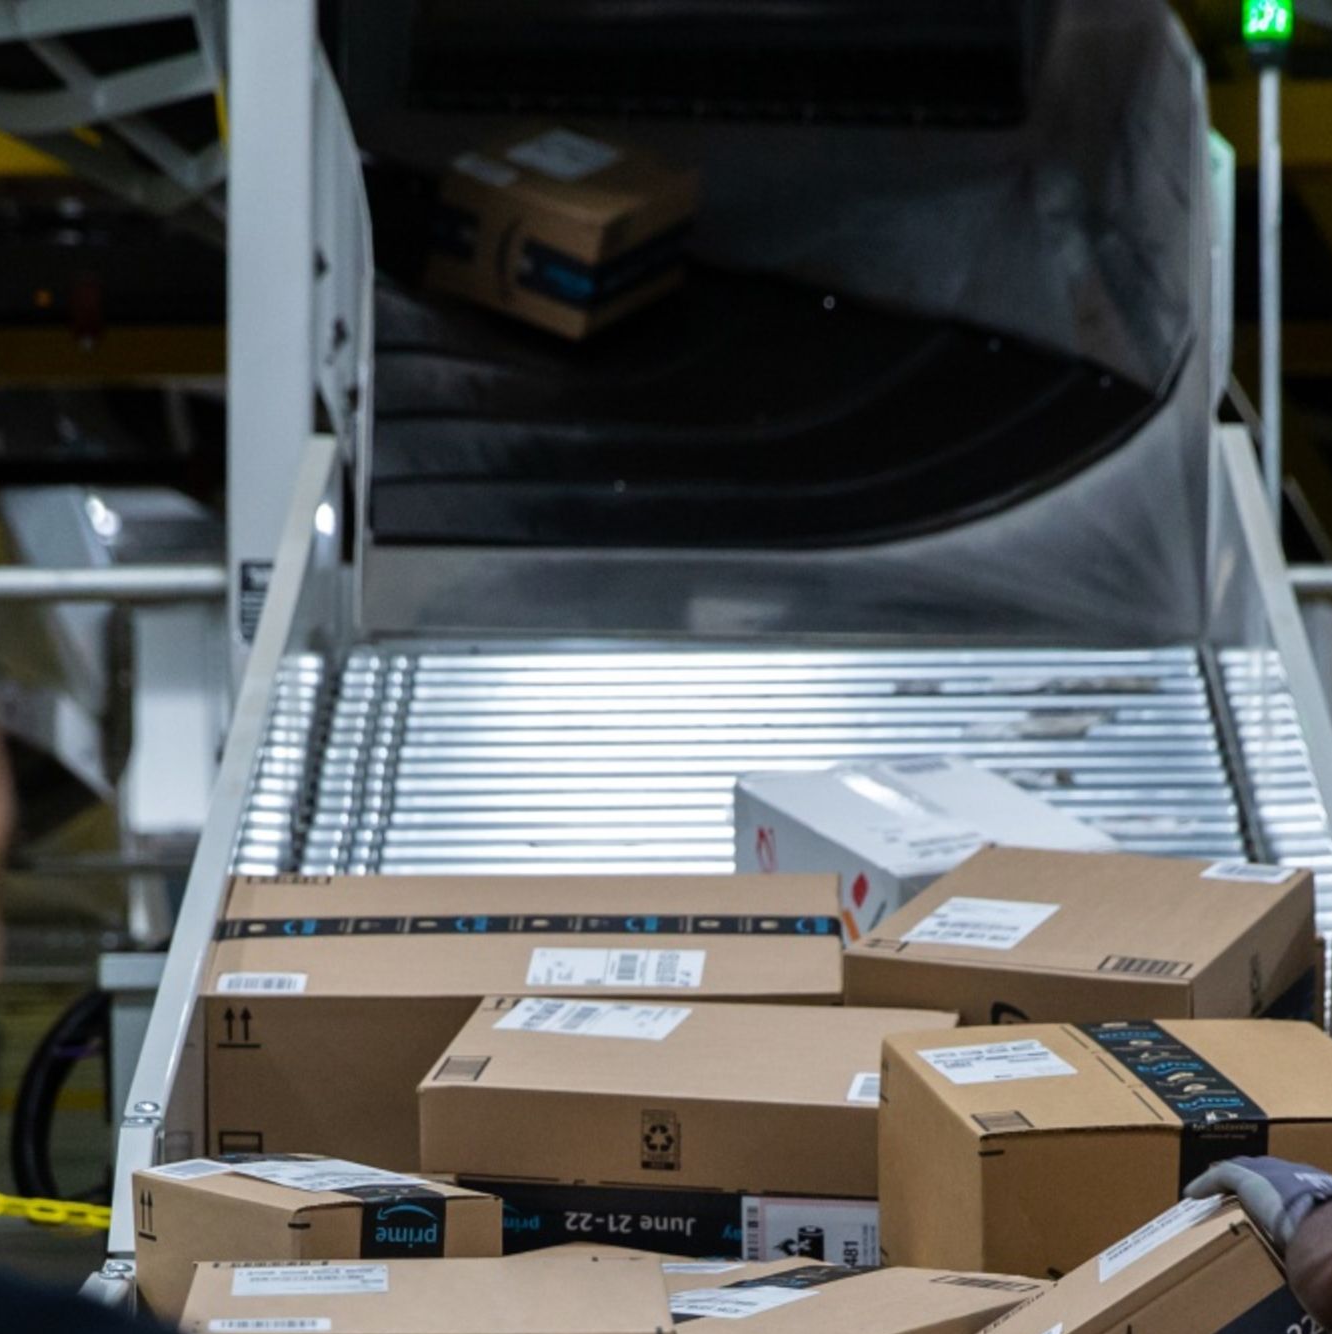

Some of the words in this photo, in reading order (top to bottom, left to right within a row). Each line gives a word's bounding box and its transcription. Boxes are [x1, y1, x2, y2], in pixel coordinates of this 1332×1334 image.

[564, 1211, 633, 1232] 21-22
[640, 1214, 697, 1236] June
[376, 1223, 438, 1247] prime
[843, 1241, 859, 1266] 481
